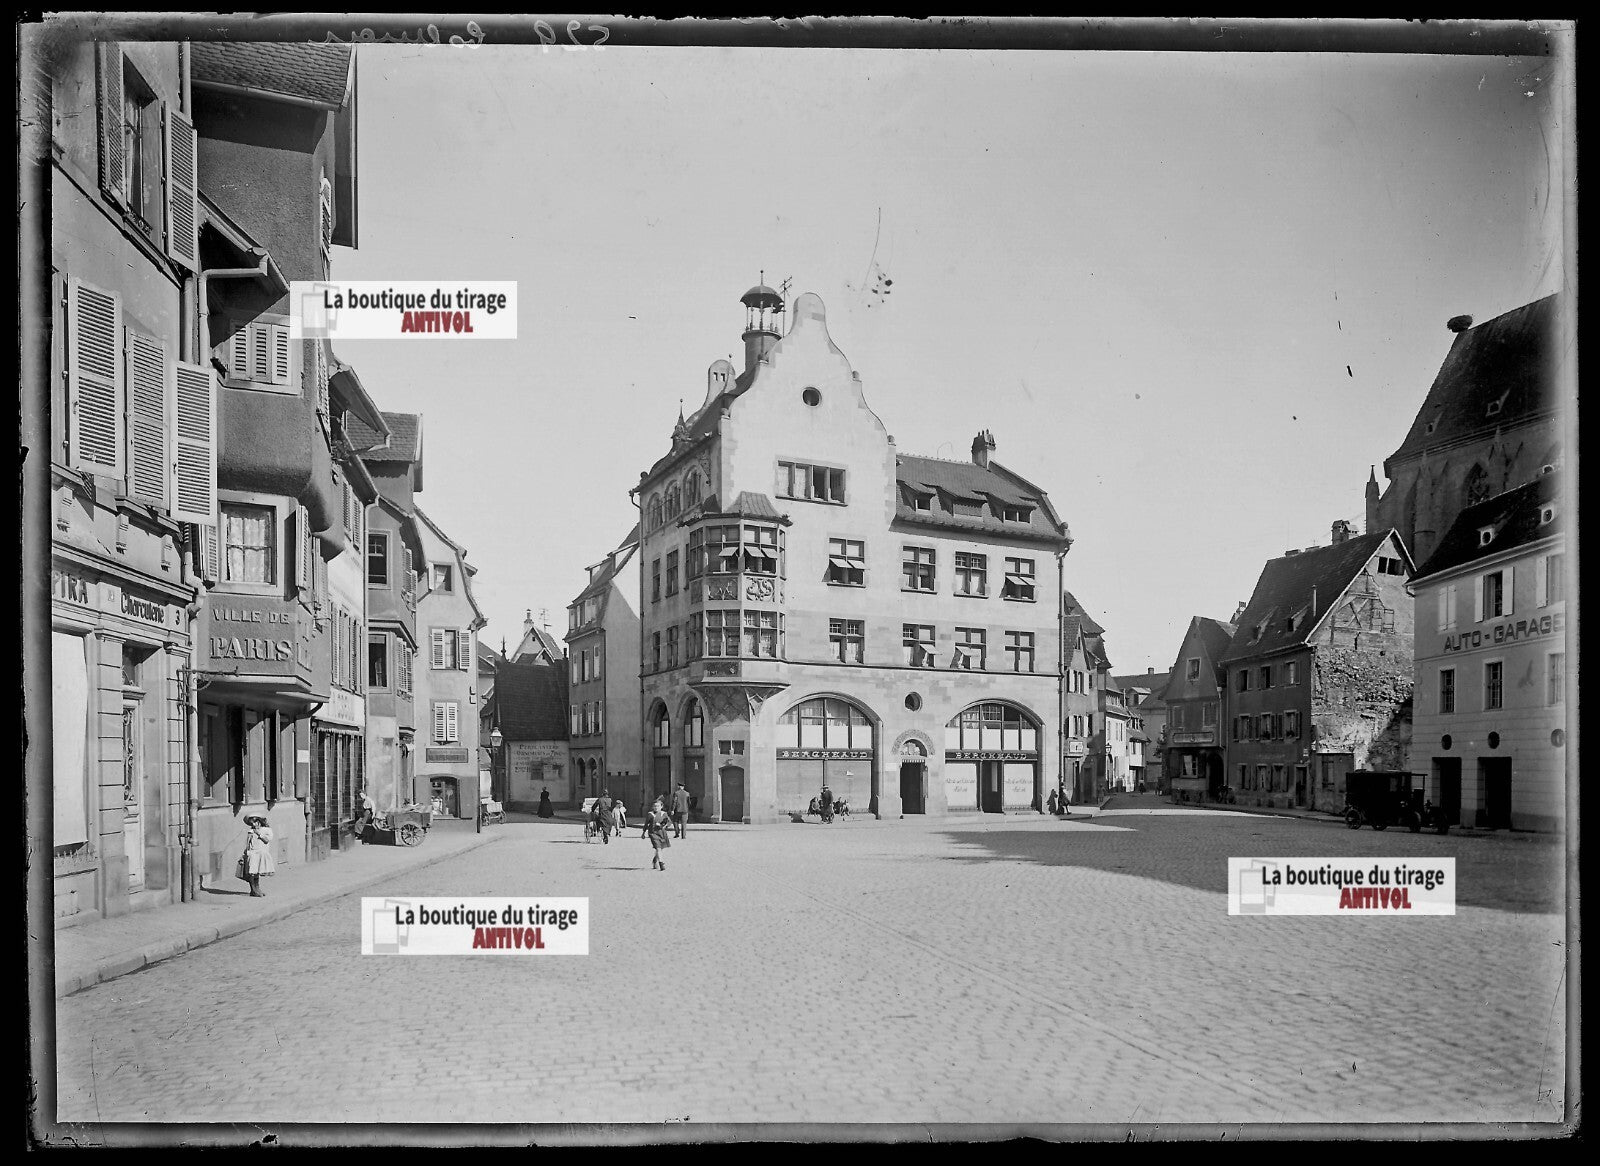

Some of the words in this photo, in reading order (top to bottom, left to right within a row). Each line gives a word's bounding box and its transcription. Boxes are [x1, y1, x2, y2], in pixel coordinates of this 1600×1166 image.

[121, 592, 165, 624] Charcuterie
[212, 608, 262, 623] VILLE
[268, 611, 290, 625] DE
[175, 609, 181, 625] 3
[209, 636, 293, 661] PARIS
[782, 750, 868, 759] BERGHEAUD
